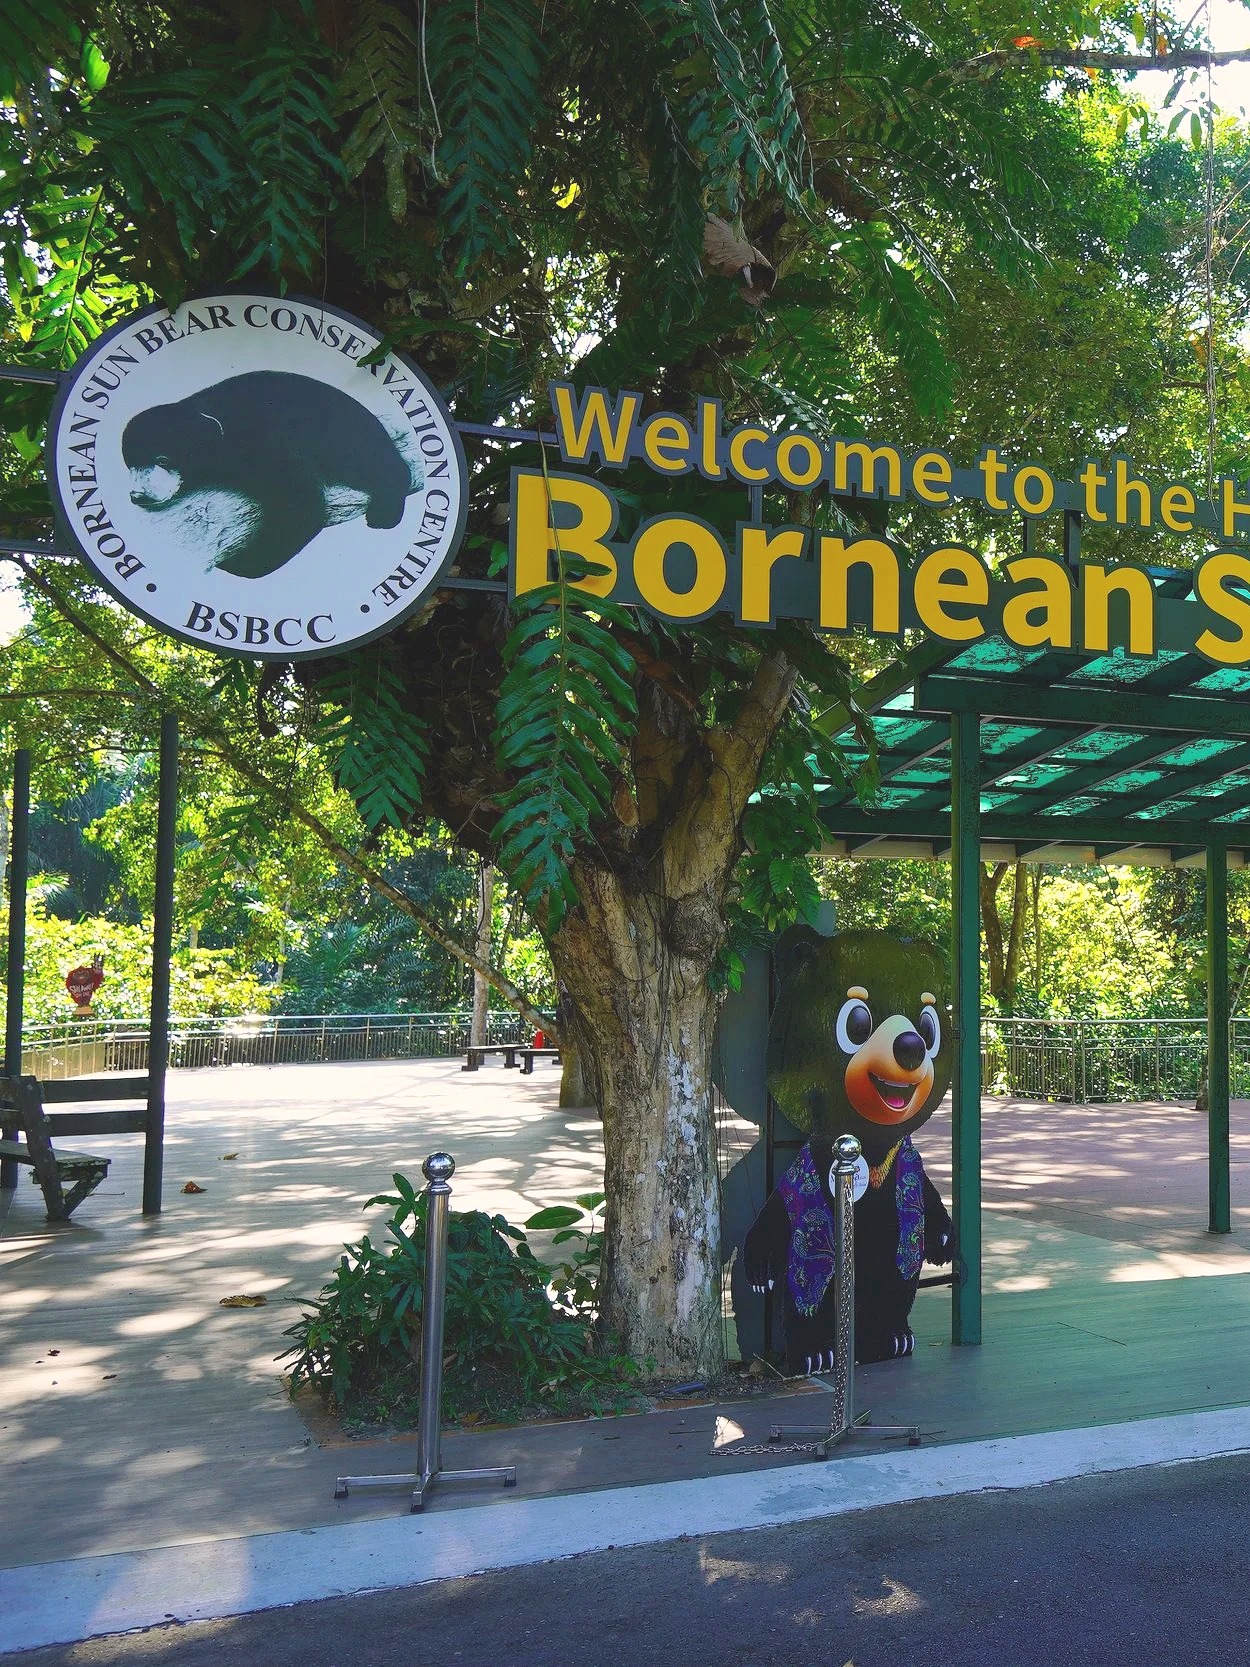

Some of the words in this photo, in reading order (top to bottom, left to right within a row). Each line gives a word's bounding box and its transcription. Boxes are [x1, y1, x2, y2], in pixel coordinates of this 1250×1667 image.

[81, 344, 140, 410] SUN
[132, 304, 237, 356] BEAR
[68, 411, 147, 582] BORNEAN
[555, 387, 951, 502] Welcome
[981, 448, 1054, 514] to
[1080, 455, 1195, 532] the
[371, 489, 450, 607] CENTRE
[515, 476, 1154, 656] Bornean
[182, 600, 336, 647] BSBCC
